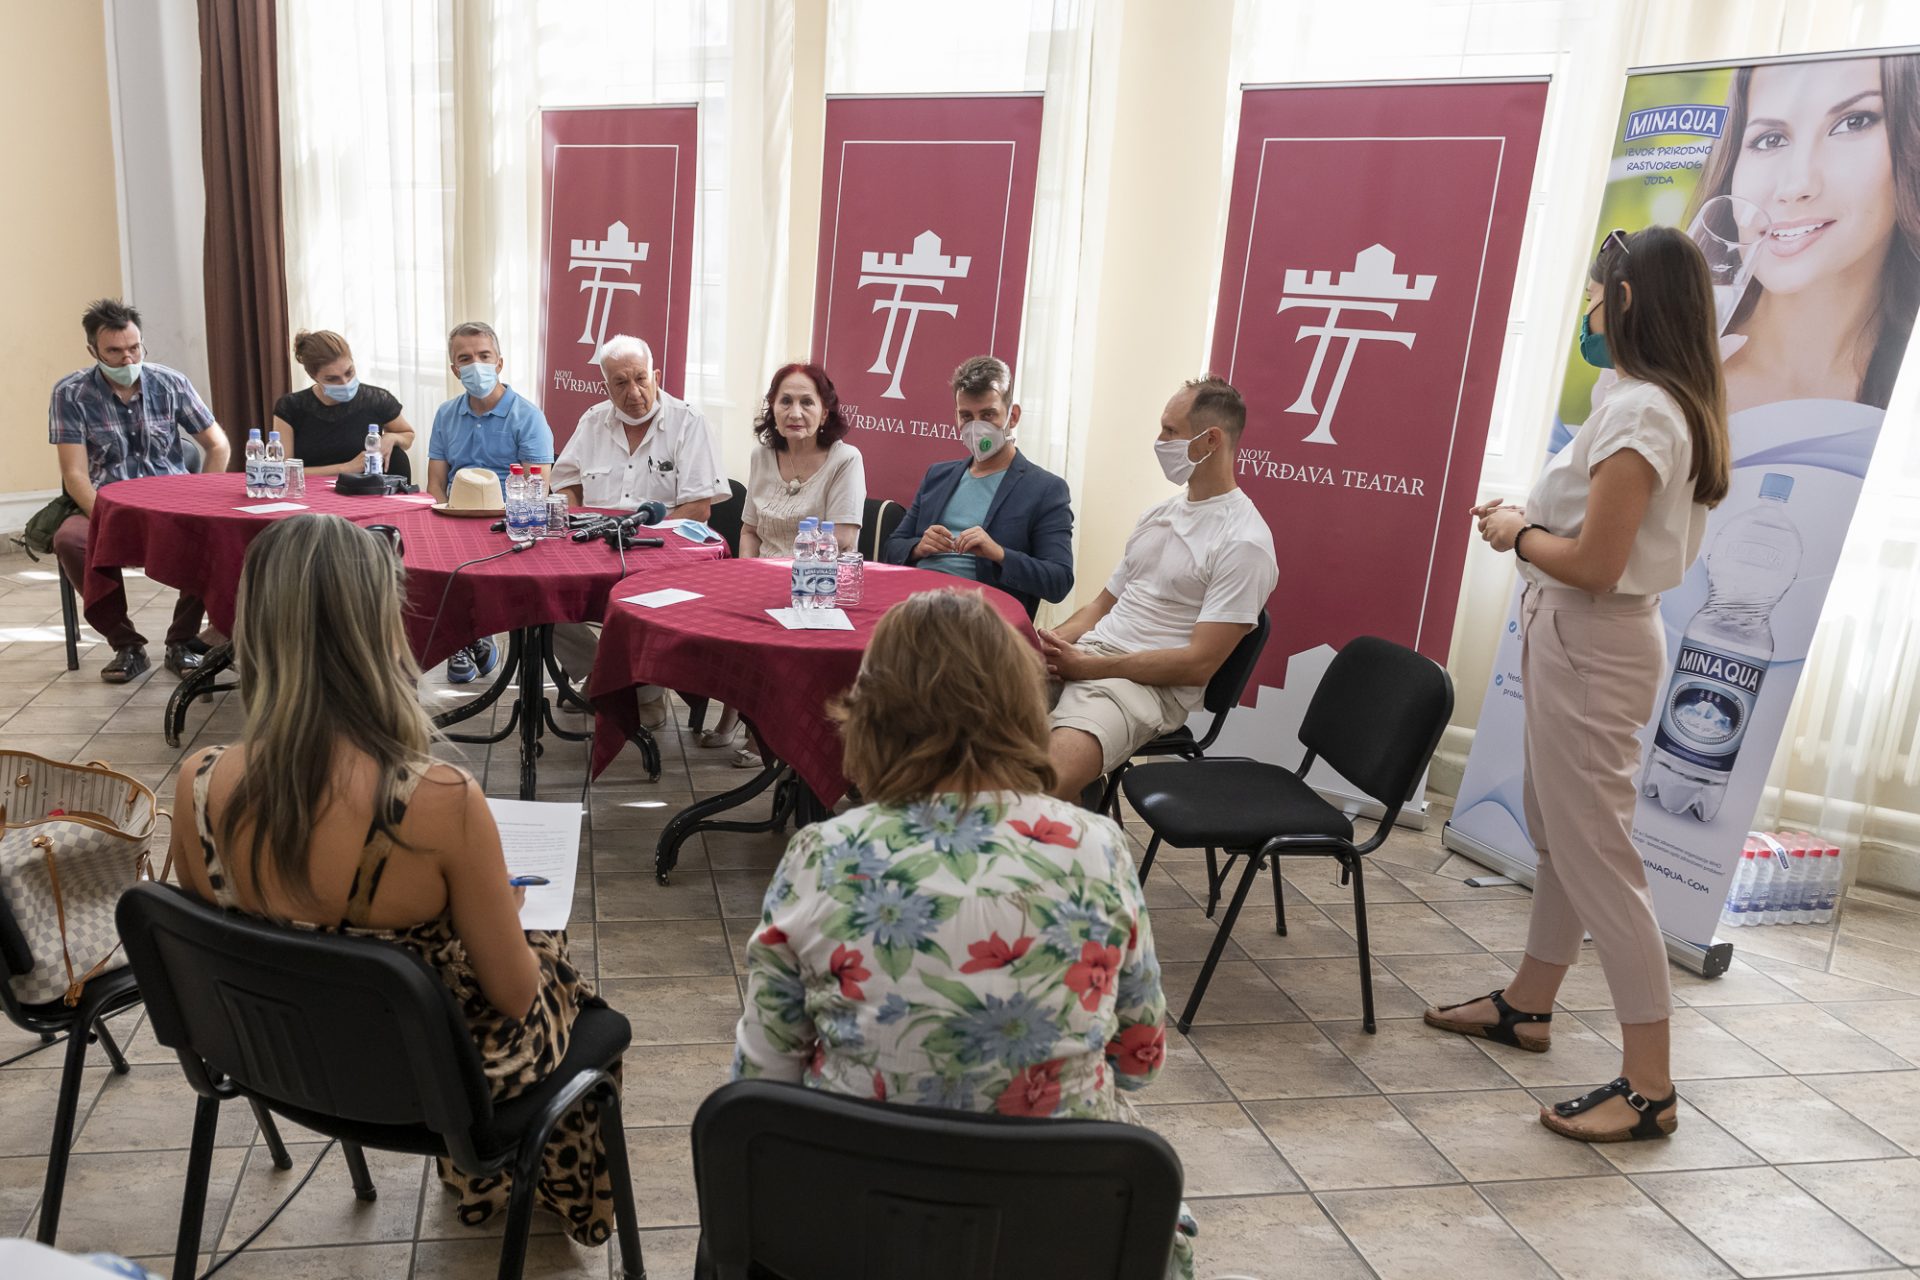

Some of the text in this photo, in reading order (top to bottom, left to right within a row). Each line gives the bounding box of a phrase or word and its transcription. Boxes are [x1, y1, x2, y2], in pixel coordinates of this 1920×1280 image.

[1630, 109, 1716, 136] MINAQUA
[1657, 145, 1713, 156] PRIRODNO
[1626, 160, 1703, 172] RASTVORENOG
[1644, 175, 1674, 186] JODA
[554, 369, 573, 379] NOVI
[841, 413, 906, 434] VRĐAVA
[1238, 448, 1271, 462] NOVI
[1236, 458, 1425, 497] TVRĐAVA TEATAR
[1680, 649, 1759, 692] MINAQUA
